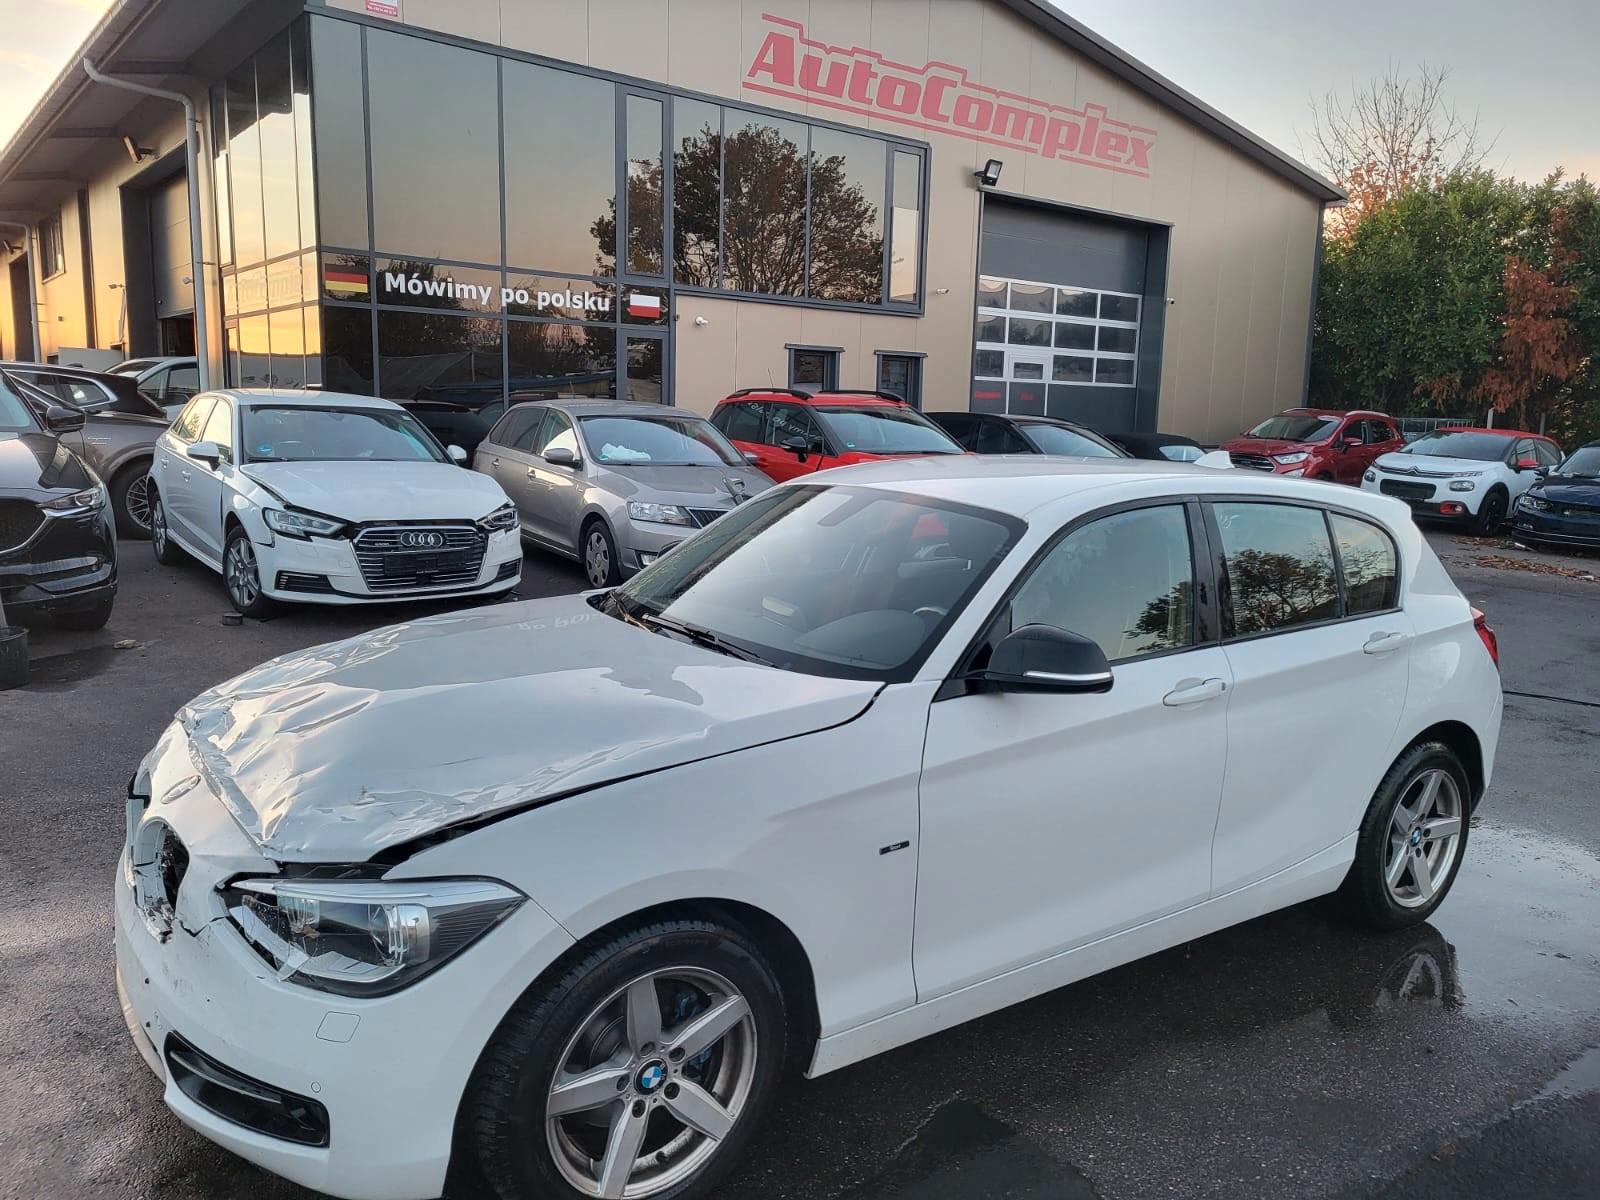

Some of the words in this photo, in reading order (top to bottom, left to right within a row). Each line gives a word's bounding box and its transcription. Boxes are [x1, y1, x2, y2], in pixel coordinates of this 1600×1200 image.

[747, 31, 1156, 169] AutoComplex
[385, 272, 492, 305] Mówimy
[501, 287, 529, 307] po
[537, 289, 610, 311] polsku
